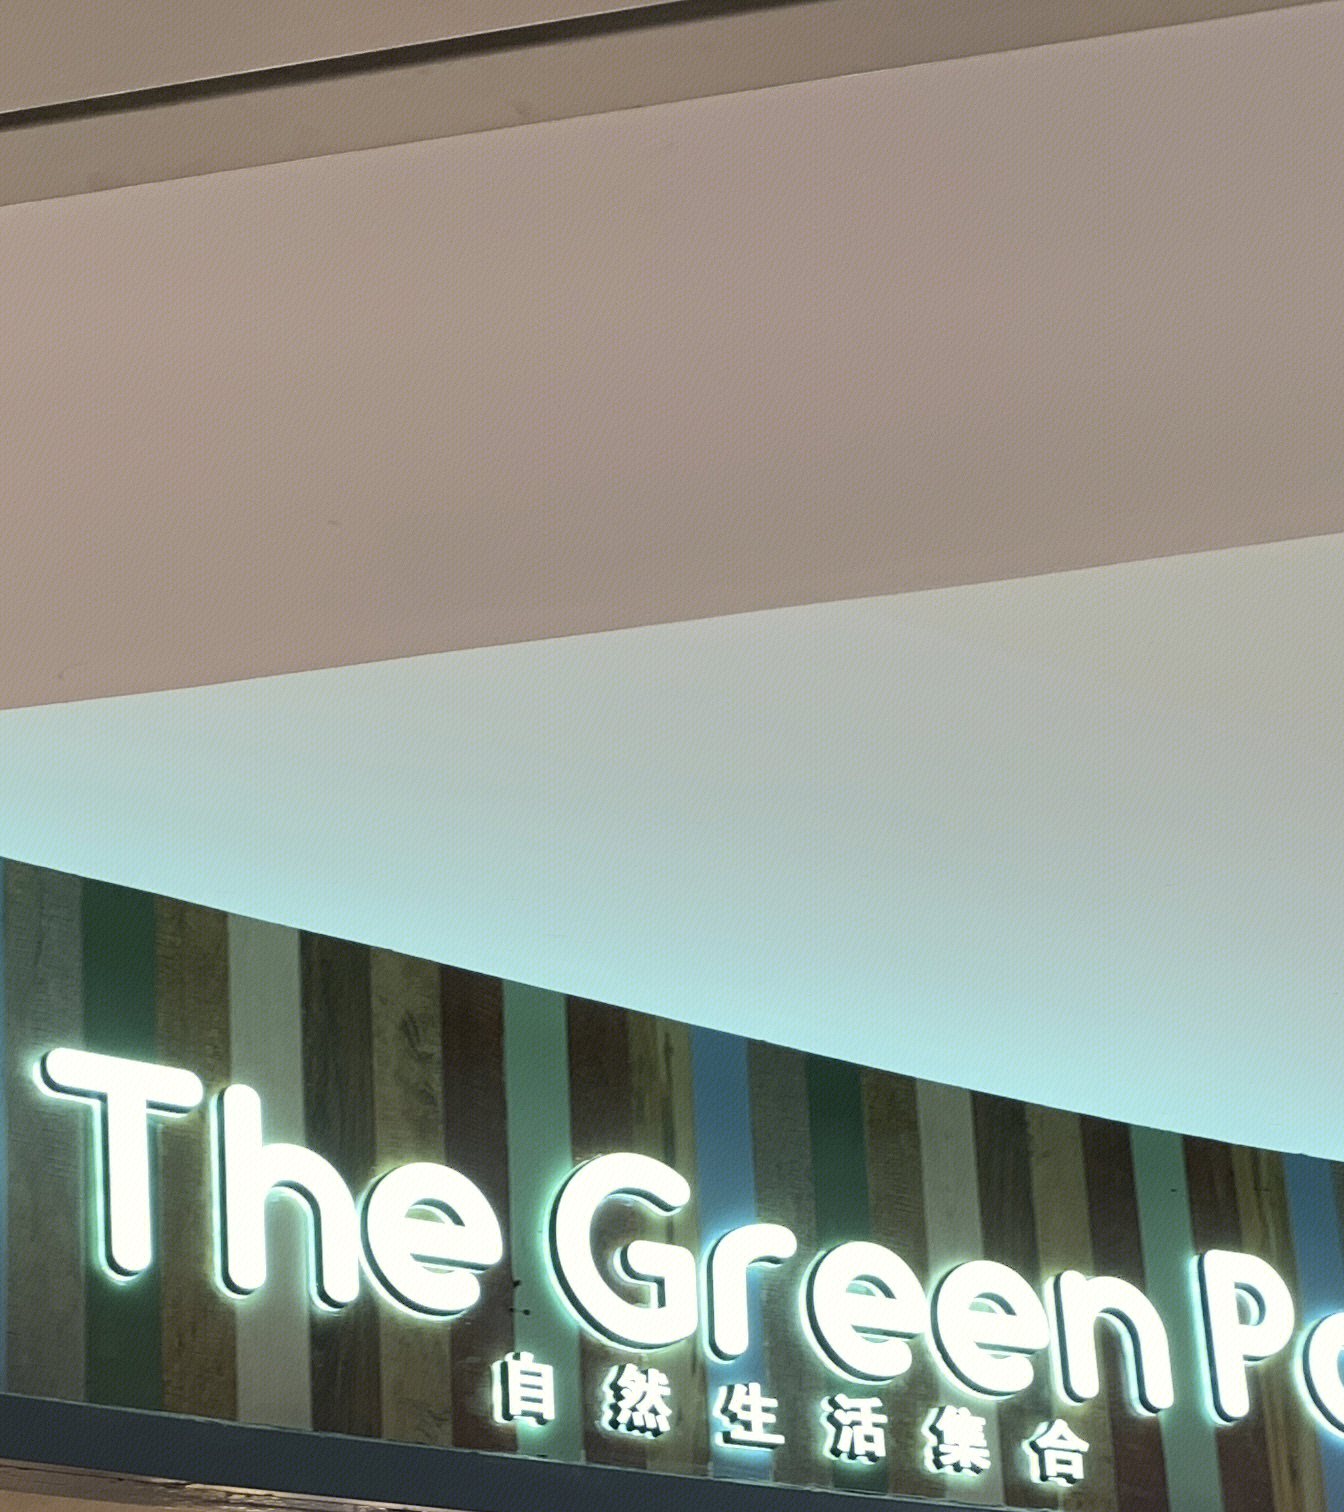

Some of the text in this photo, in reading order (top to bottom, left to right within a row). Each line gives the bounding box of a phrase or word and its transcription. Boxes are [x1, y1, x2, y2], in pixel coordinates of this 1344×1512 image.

[40, 1047, 504, 1319] The
[547, 1151, 1175, 1420] Green
[496, 1352, 1092, 1486] 自然生活集合
